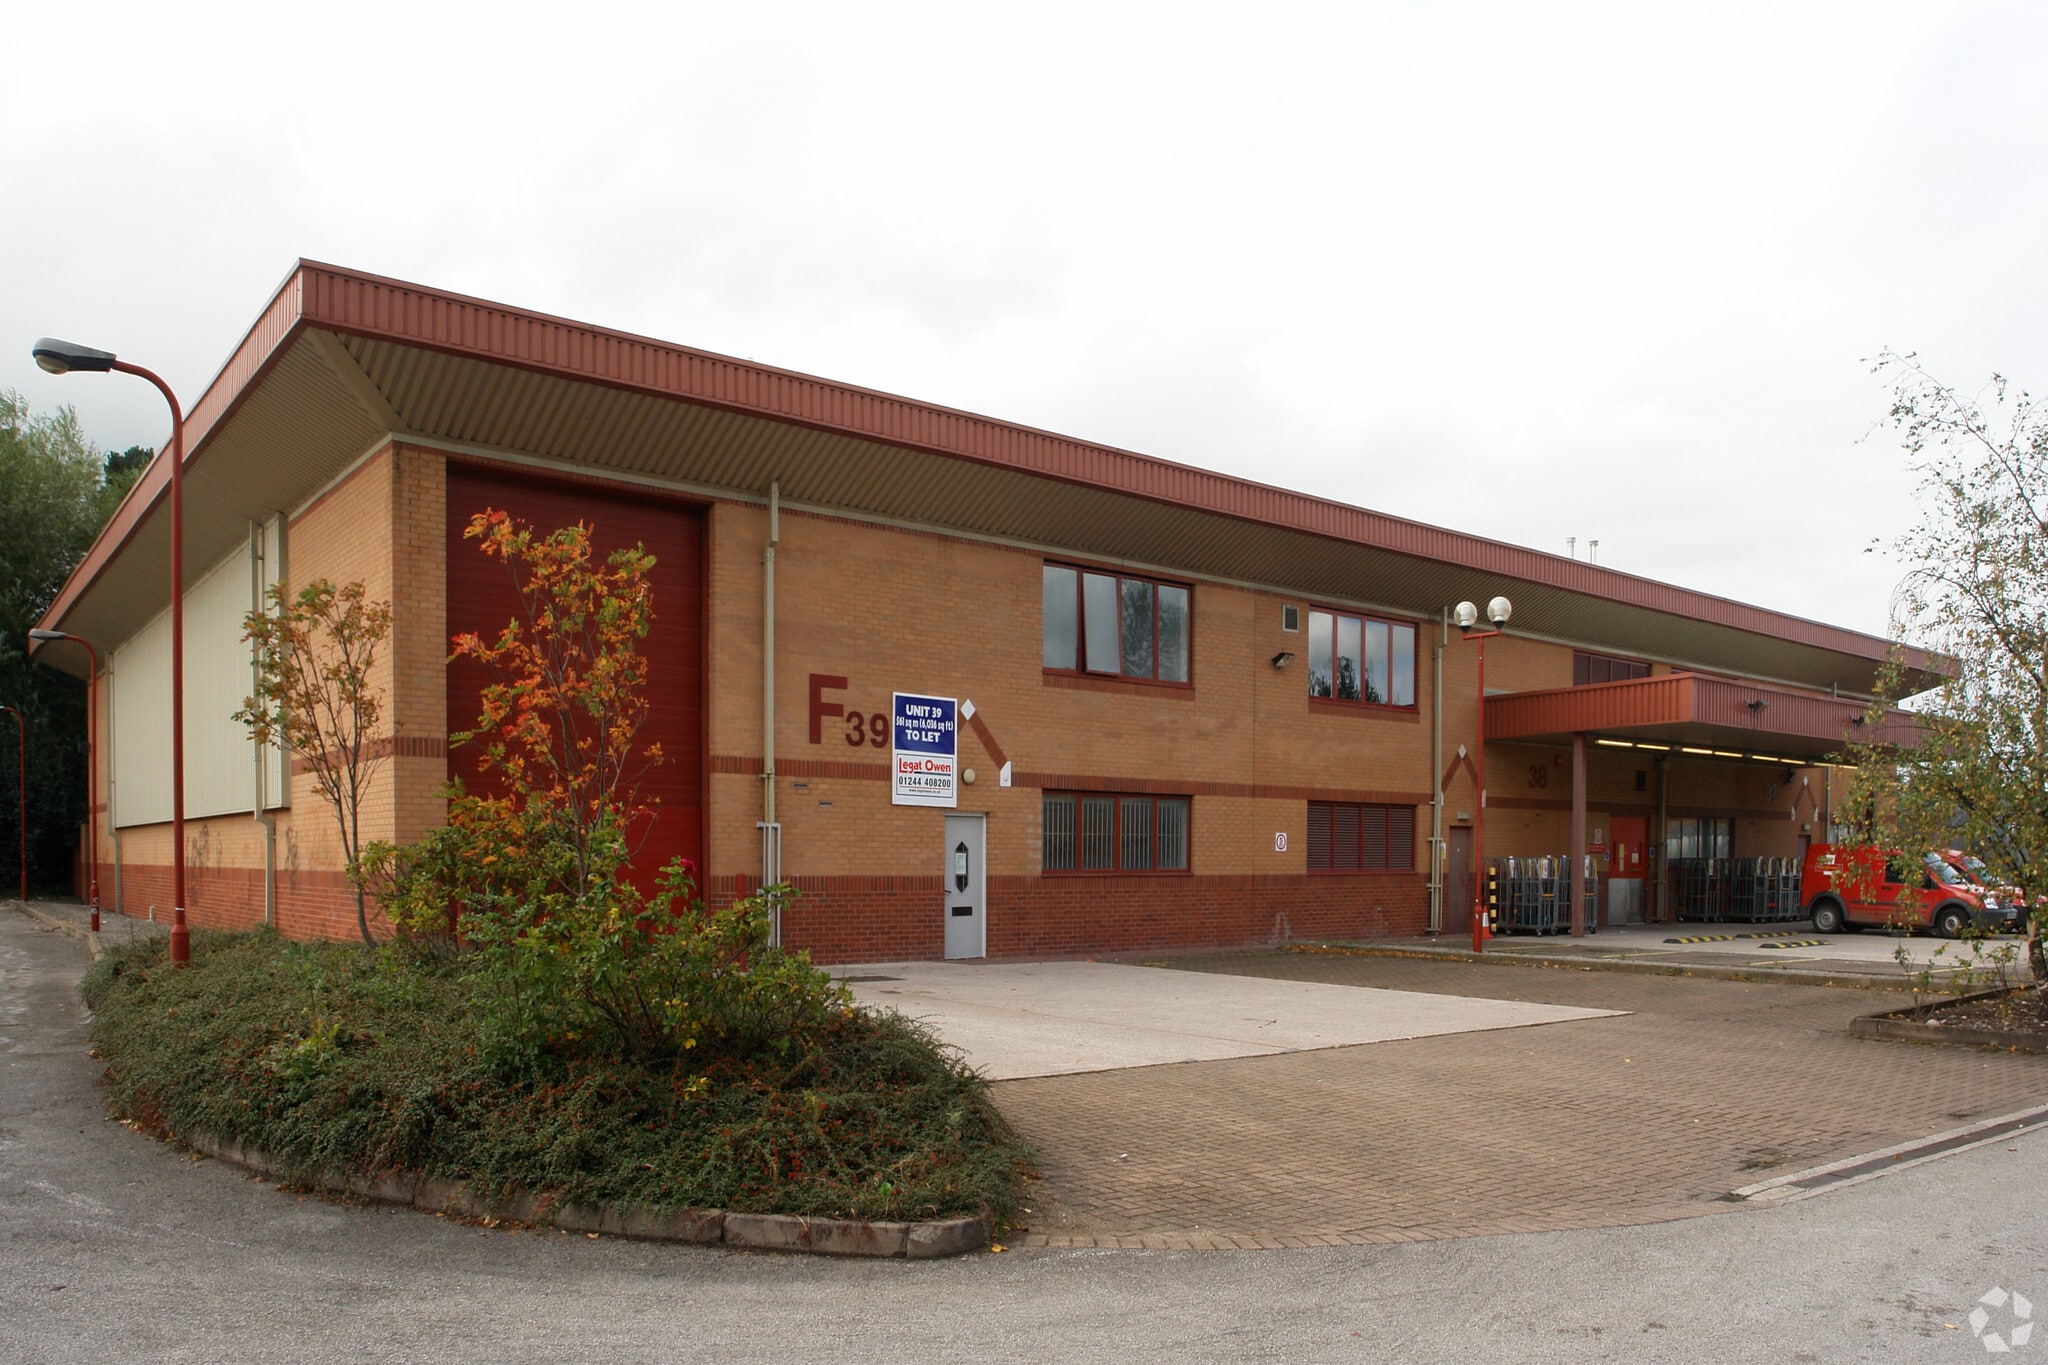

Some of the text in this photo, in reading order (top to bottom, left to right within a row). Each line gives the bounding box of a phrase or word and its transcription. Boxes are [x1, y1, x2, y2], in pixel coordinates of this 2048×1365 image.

[906, 704, 942, 718] UNIT 39
[905, 719, 912, 729] sq
[912, 720, 918, 728] m
[938, 722, 945, 733] sq
[905, 729, 941, 743] TO LET
[899, 757, 951, 774] Legat Owen
[899, 776, 951, 788] 01244 408200
